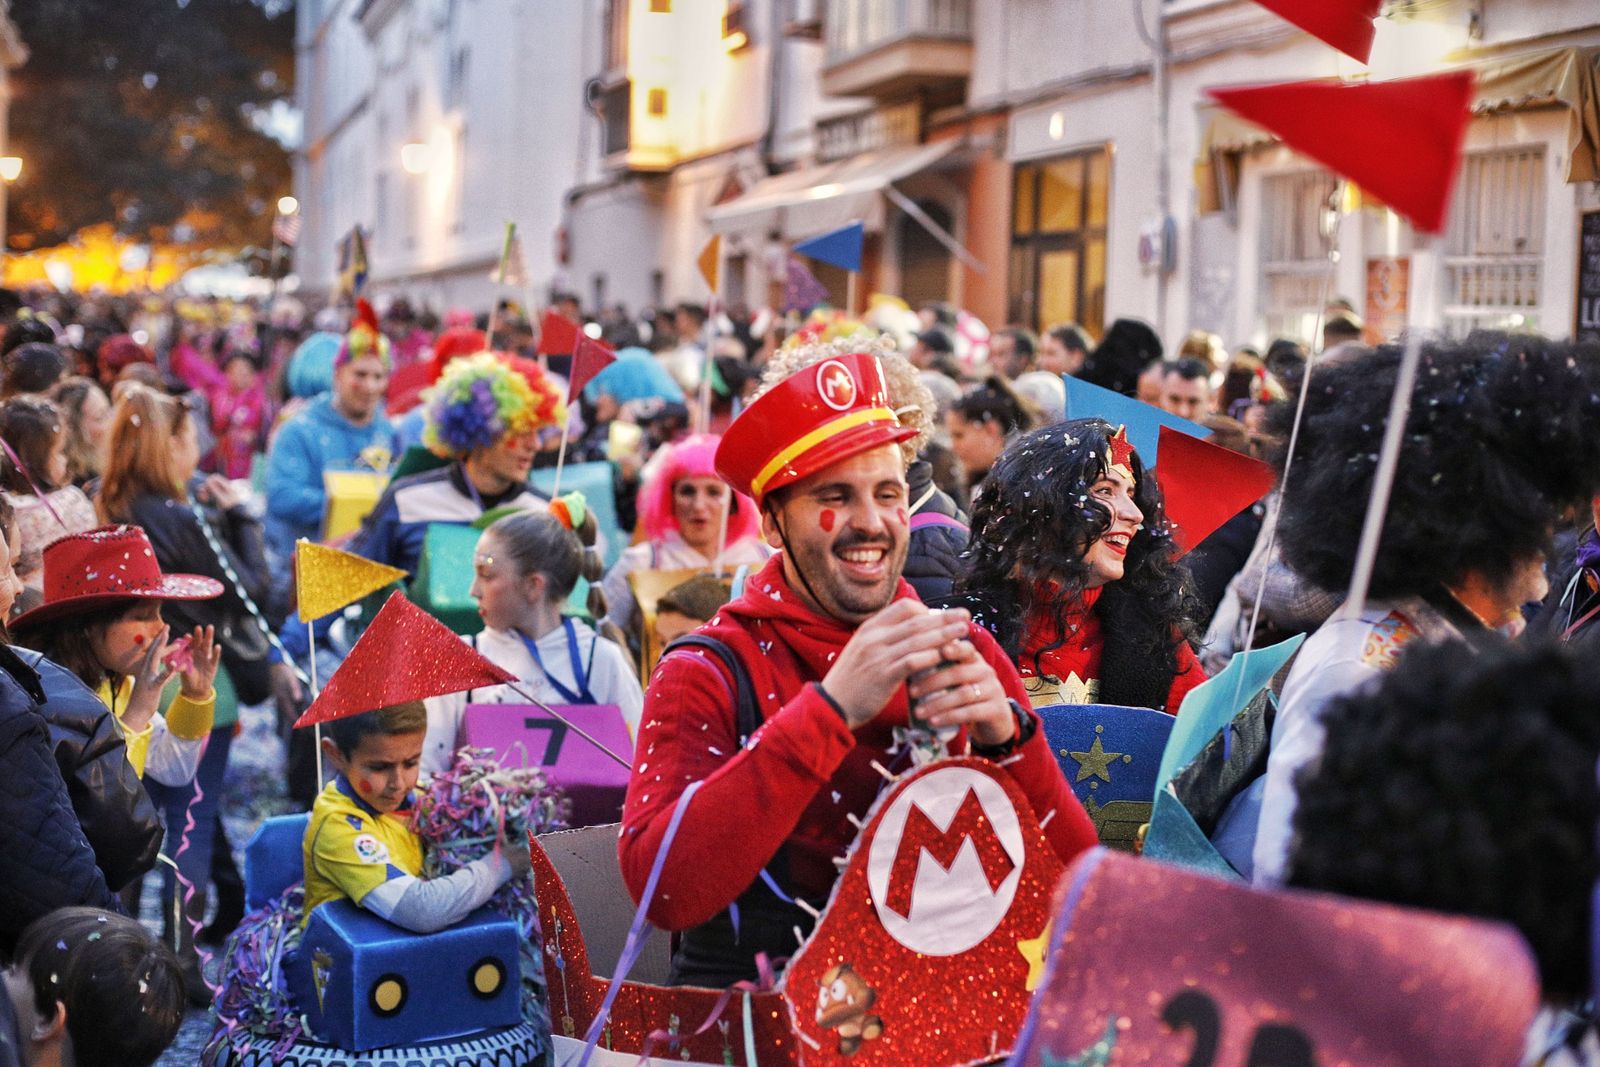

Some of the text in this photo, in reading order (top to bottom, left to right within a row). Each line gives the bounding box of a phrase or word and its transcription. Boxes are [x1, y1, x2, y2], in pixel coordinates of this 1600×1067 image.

[826, 371, 852, 398] M
[525, 717, 568, 766] 7
[885, 784, 1016, 922] M
